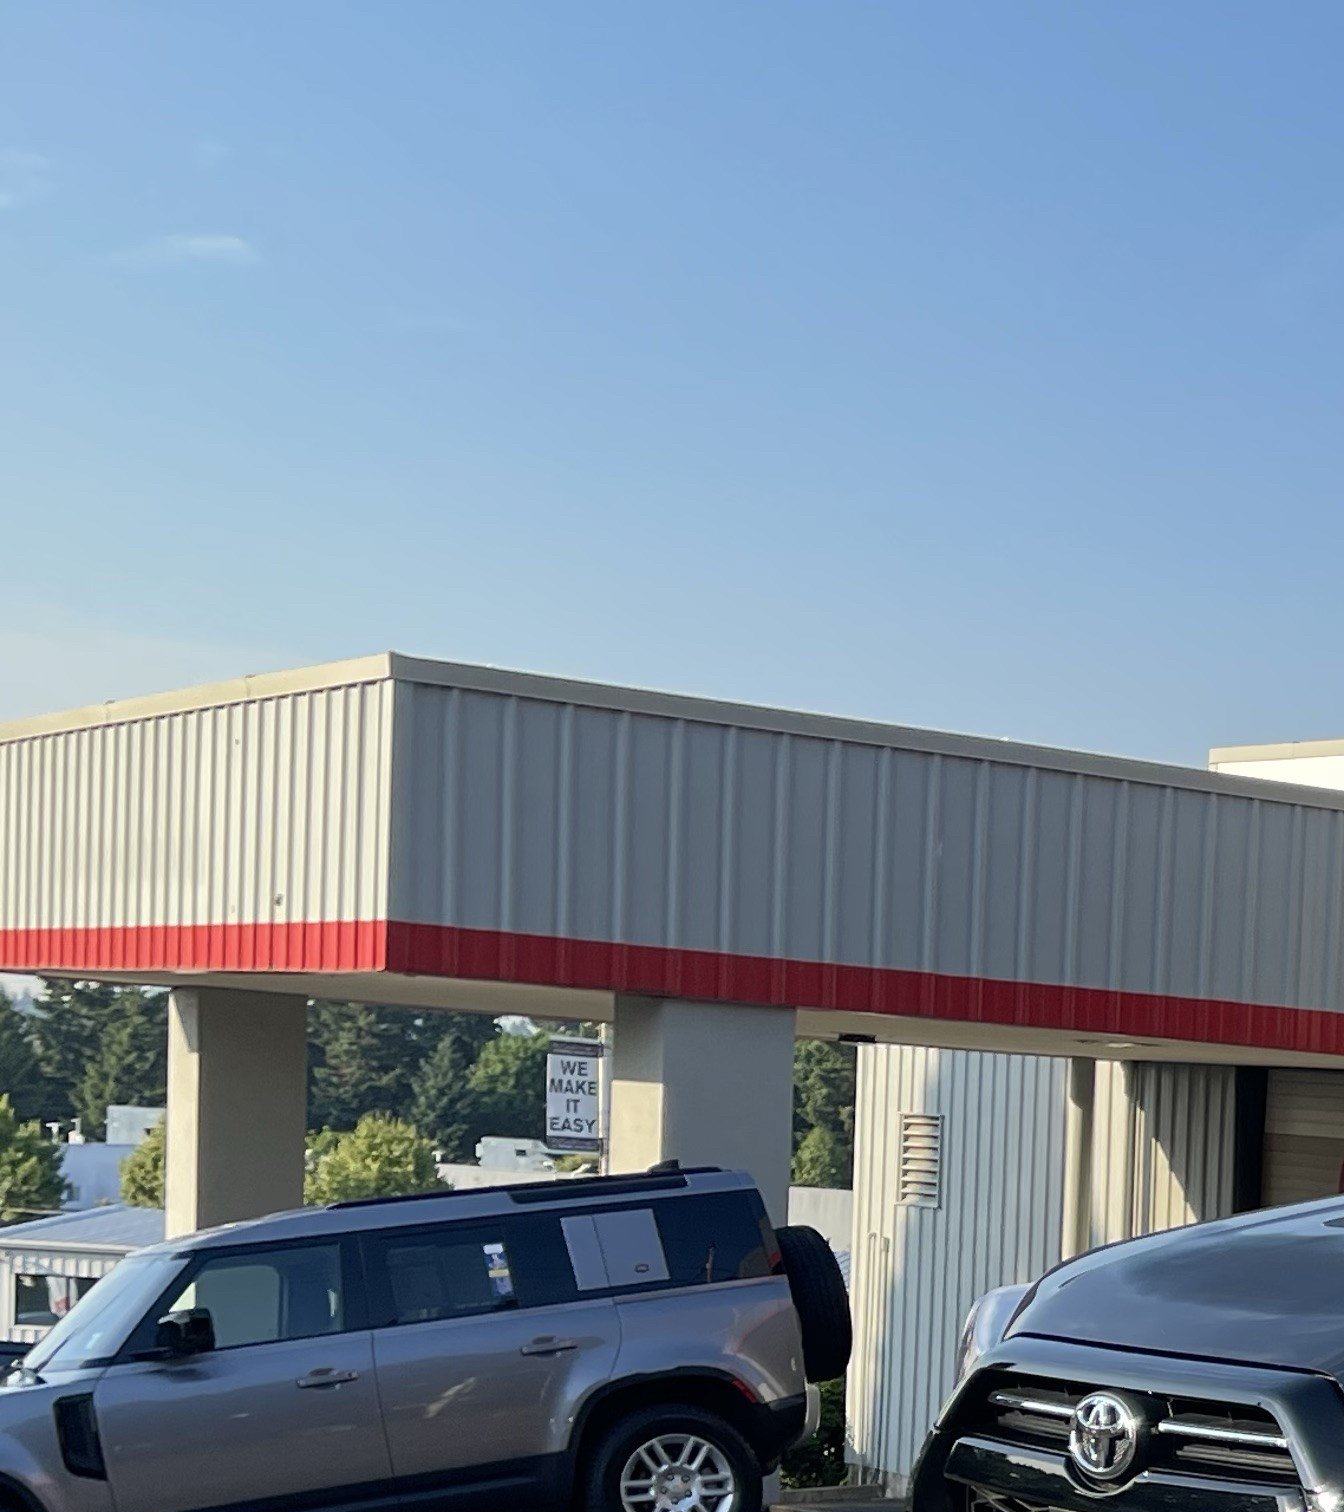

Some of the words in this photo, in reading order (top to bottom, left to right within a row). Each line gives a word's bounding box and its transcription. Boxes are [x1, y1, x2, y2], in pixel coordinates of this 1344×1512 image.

[560, 1060, 588, 1076] WE
[548, 1078, 597, 1096] MAKE
[566, 1098, 581, 1113] IT
[548, 1116, 596, 1133] EASY
